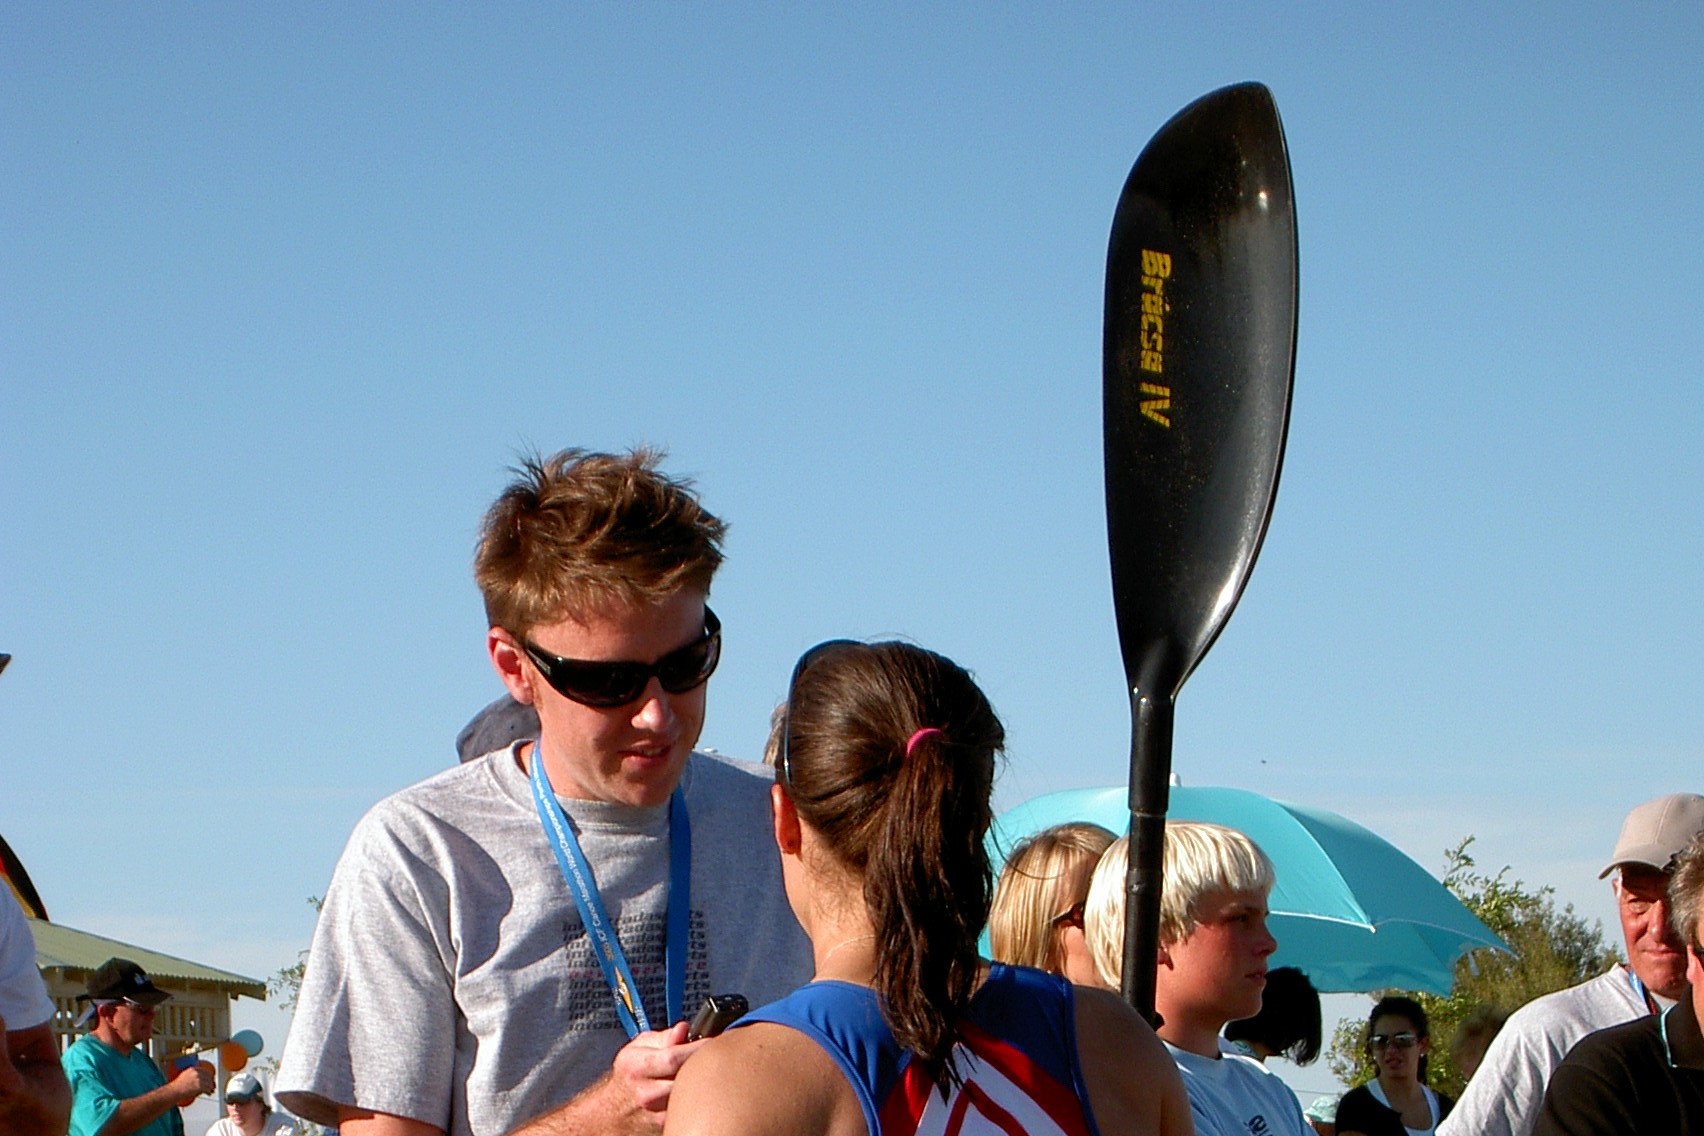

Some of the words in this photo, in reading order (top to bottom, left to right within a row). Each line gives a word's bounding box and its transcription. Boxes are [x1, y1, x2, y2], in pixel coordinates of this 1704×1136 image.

[1140, 382, 1171, 428] IV
[543, 798, 568, 848] Championships
[562, 848, 576, 869] World
[573, 868, 590, 901] Marathon
[587, 902, 601, 927] Canoe
[595, 927, 607, 942] ICF
